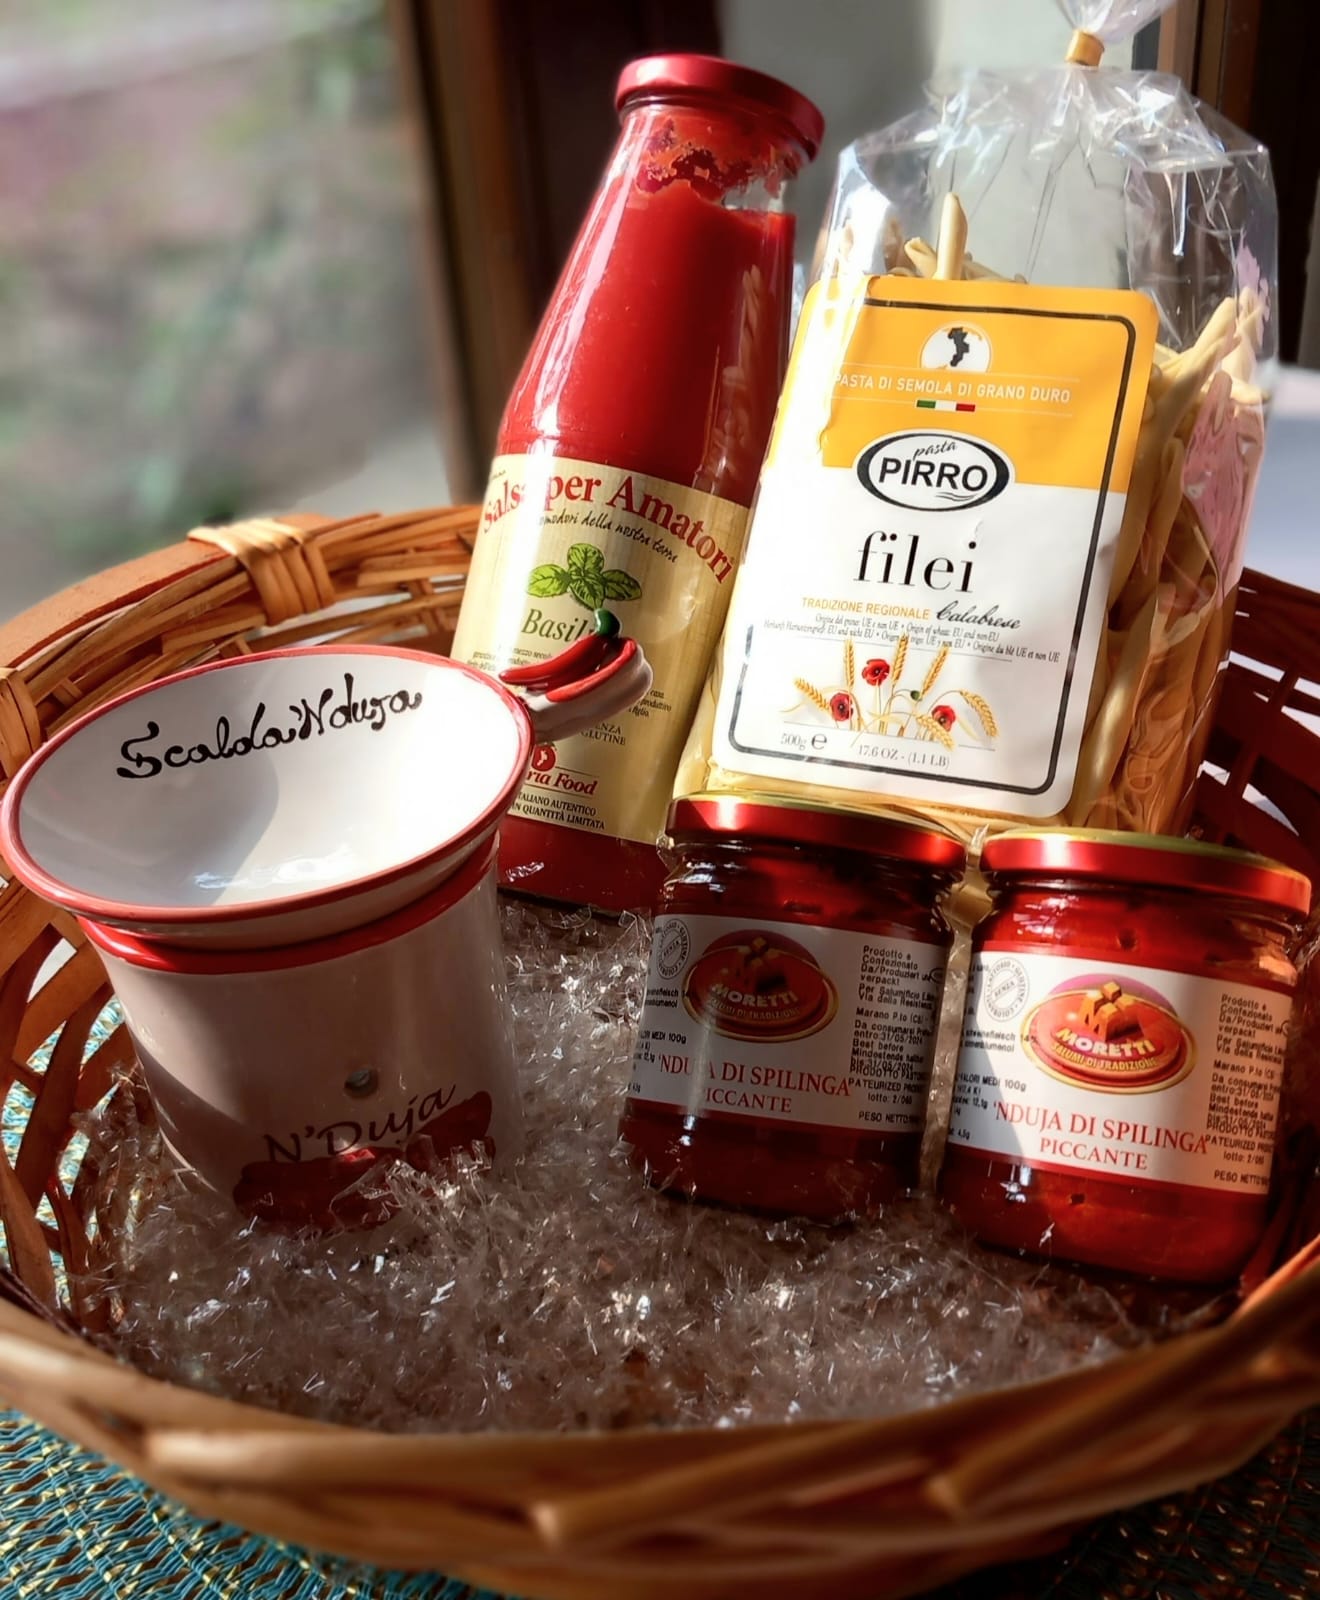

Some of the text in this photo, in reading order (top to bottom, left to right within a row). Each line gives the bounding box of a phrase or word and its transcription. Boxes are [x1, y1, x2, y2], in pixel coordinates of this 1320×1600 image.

[878, 376, 893, 390] DI
[896, 377, 953, 395] SEMOLA
[957, 382, 972, 396] DI
[976, 384, 1026, 399] GRANO
[1030, 386, 1071, 403] DURO
[912, 439, 958, 461] pasta
[877, 456, 988, 493] PIRRO
[543, 475, 602, 512] per
[606, 475, 734, 584] Amatori
[580, 510, 613, 530] della
[615, 523, 651, 546] nostra
[852, 530, 977, 593] filei
[521, 608, 594, 642] Basil
[802, 597, 1021, 629] TRADIZIONE REGIONALE Calabrese
[553, 773, 598, 795] Food
[550, 799, 597, 817] AUTENTICO
[567, 815, 606, 830] LIMITATA
[862, 954, 918, 970] Confezionato
[863, 945, 903, 960] Prodotto
[711, 983, 799, 1008] MORETTI
[1221, 993, 1259, 1010] Prodotto
[854, 1019, 868, 1030] Da
[856, 1007, 890, 1020] Marano
[1055, 1027, 1156, 1057] MORETTI
[1051, 1042, 1085, 1064] SALUMI
[1086, 1057, 1097, 1068] DI
[1213, 1059, 1246, 1073] Marano
[721, 1061, 746, 1084] DI
[750, 1066, 851, 1097] SPILINGA
[1004, 1079, 1027, 1092] 100g
[1211, 1073, 1224, 1084] Da
[704, 1087, 792, 1114] ICCANTE
[263, 1084, 457, 1163] N'Duja
[858, 1111, 882, 1121] PESO
[993, 1100, 1208, 1155] 'NDUJA DI SPILINGA
[1039, 1137, 1148, 1170] PICCANTE
